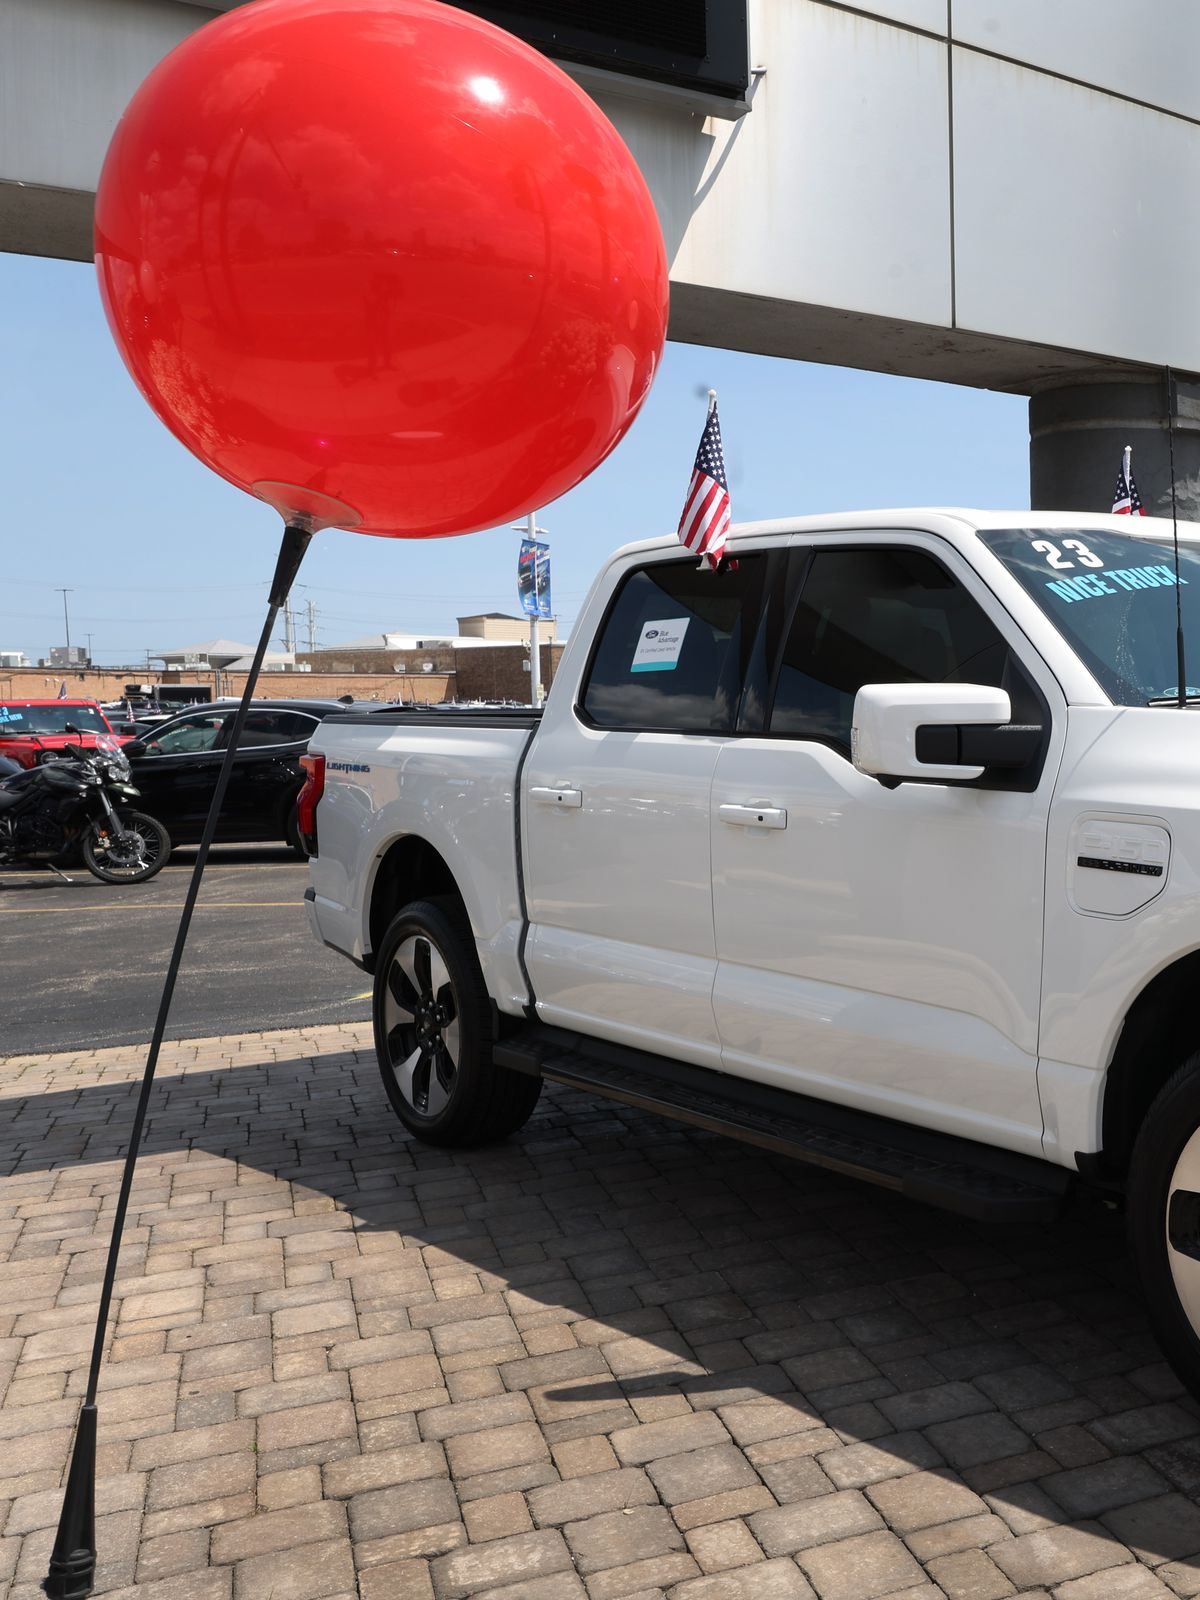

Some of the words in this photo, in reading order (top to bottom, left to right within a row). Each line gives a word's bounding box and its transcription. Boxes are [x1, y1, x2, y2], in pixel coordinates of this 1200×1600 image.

[1031, 539, 1104, 570] 23
[1045, 573, 1118, 604] NICE
[1102, 565, 1189, 591] TRUCK
[326, 762, 370, 774] LIGHTNING
